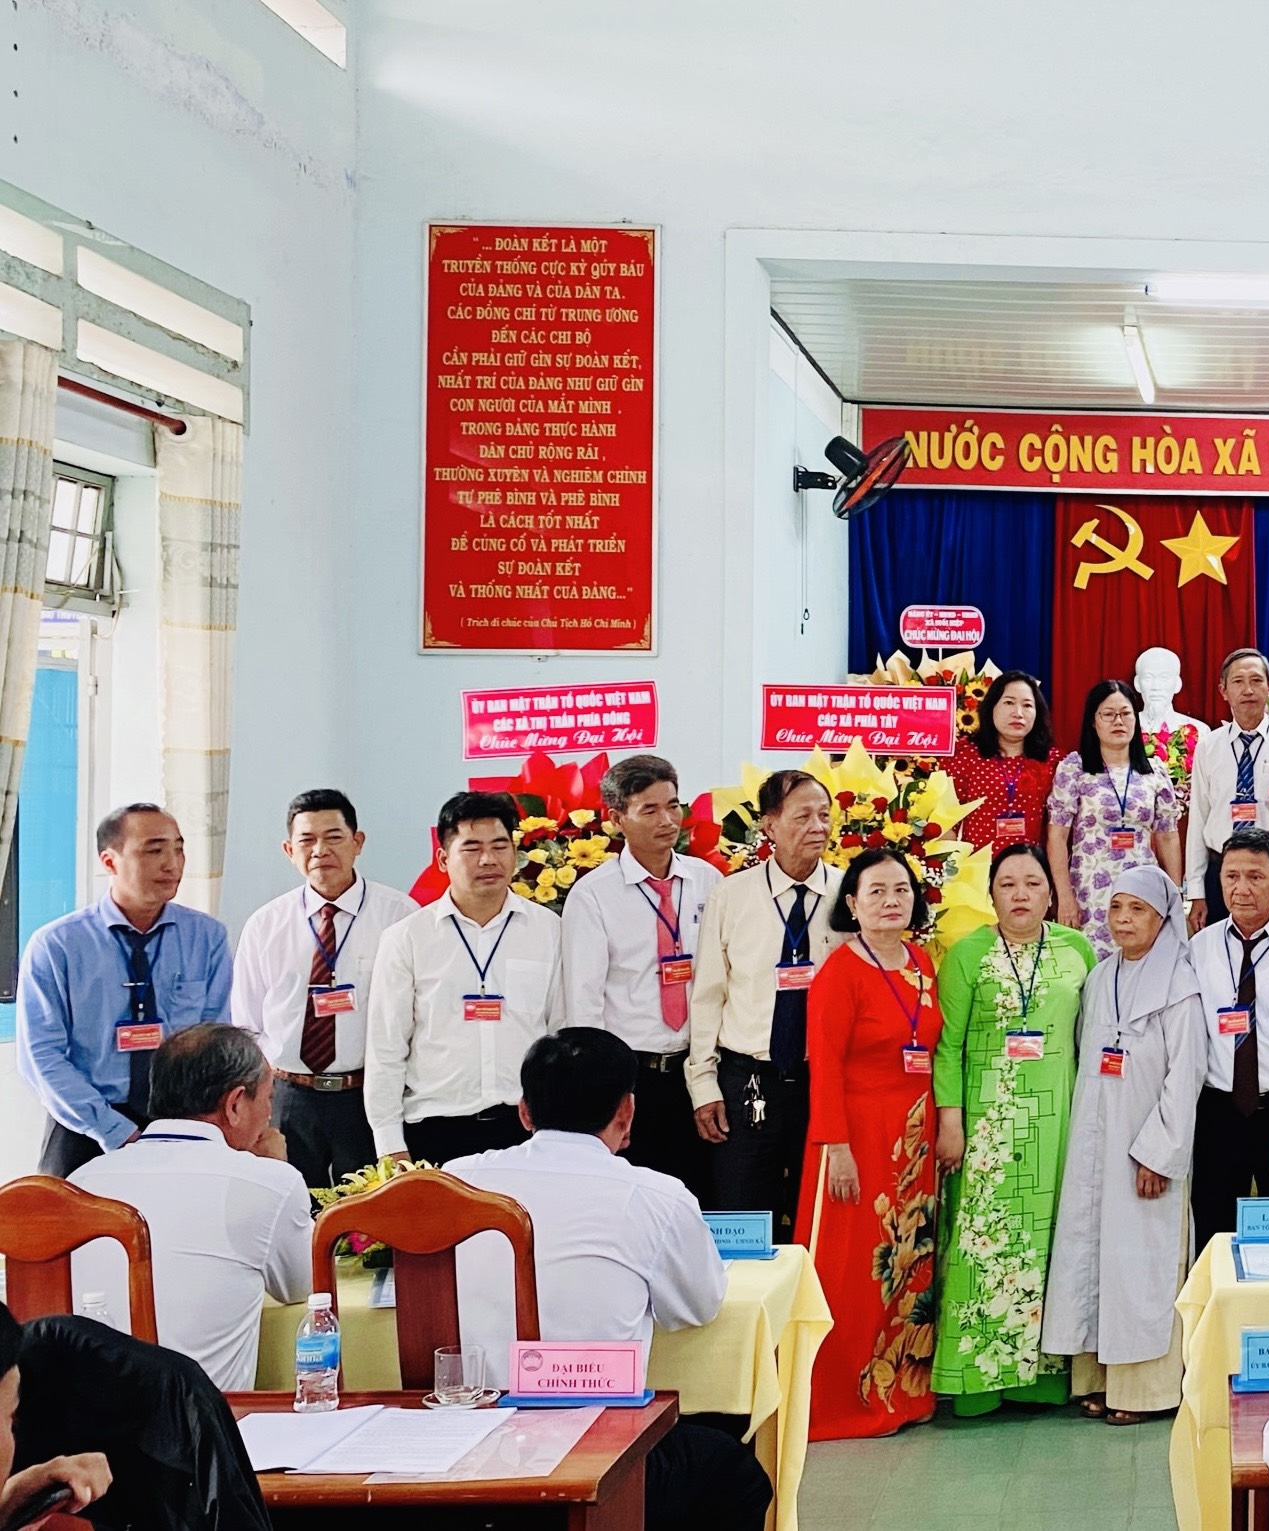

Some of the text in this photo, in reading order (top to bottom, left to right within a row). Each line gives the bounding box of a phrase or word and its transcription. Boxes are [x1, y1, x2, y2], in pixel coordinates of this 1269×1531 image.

[495, 234, 528, 250] ĐOÀN
[532, 233, 557, 251] KẾT
[562, 236, 576, 251] LÀ
[581, 236, 607, 256] MỘT
[443, 254, 491, 273] TRUYỀN
[495, 255, 536, 274] THỐNG
[541, 261, 566, 278] CỰC
[570, 259, 587, 275] KỲ
[620, 260, 644, 277] BÁU
[460, 278, 484, 297] CỦA
[488, 279, 522, 297] ĐẢNG
[526, 282, 542, 297] VÀ
[547, 280, 571, 298] CỦA
[576, 282, 600, 299] DÂN
[448, 300, 638, 323] CÁC ĐỒNG CHÍ TỪ TRUNG ƯƠNG
[492, 324, 591, 347] ĐẾN CÁC CHI BỘ
[904, 420, 1004, 470] NƯỚC
[1019, 425, 1118, 483] CỘNG
[1133, 425, 1202, 475] HÒA
[1212, 429, 1261, 476] XÃ
[480, 509, 599, 529] LÀ CÁCH TỐT NHẤT
[487, 700, 507, 713] BAN
[510, 696, 531, 714] MẶT
[532, 694, 558, 712] TRẬN
[576, 690, 603, 709] QUỐC
[605, 691, 626, 708] VIỆT
[629, 691, 651, 704] NAM
[786, 695, 805, 707] BAN
[808, 694, 829, 710] MẶT
[831, 693, 856, 711] TRẬN
[873, 692, 900, 710] QUỐC
[902, 695, 922, 712] VIỆT
[925, 698, 947, 711] NAM
[493, 716, 513, 732] CÁC
[818, 712, 837, 727] CÁC
[855, 713, 878, 727] PHÍA
[480, 728, 643, 750] Chúc Mừng Đại Hội
[776, 728, 812, 743] Chúc
[869, 731, 899, 747] Đại
[907, 731, 938, 749] Hội
[538, 1377, 576, 1388] CHÍNH
